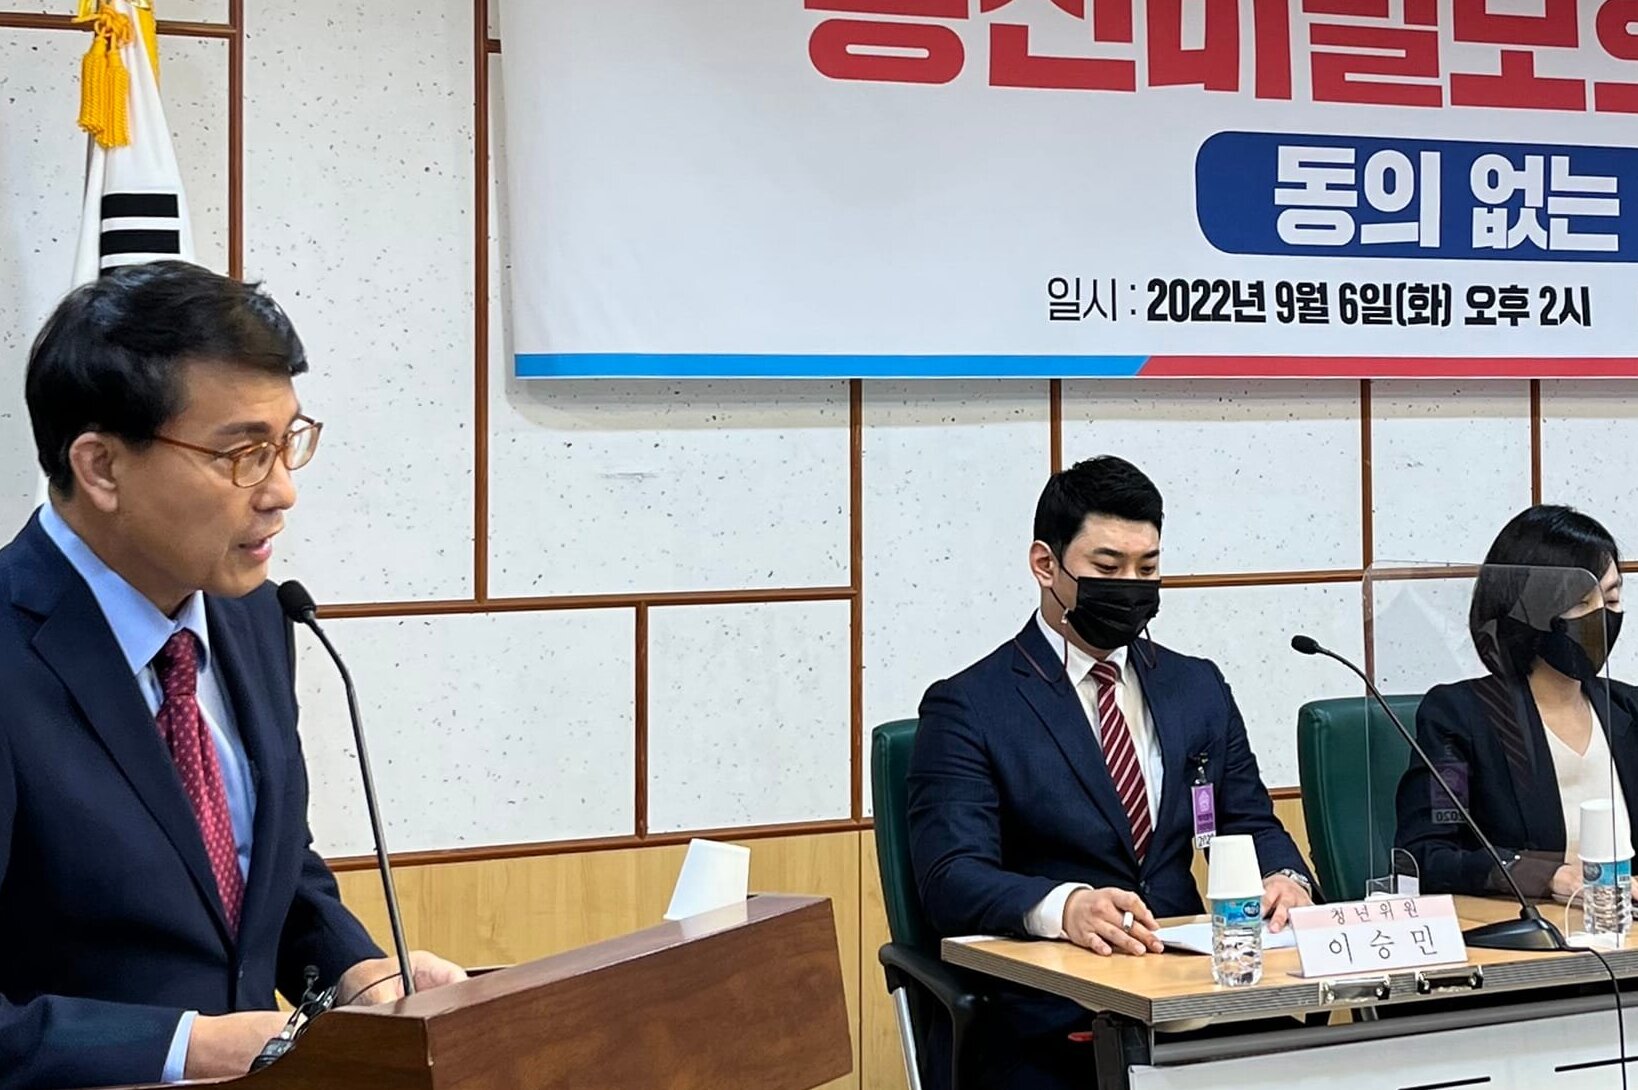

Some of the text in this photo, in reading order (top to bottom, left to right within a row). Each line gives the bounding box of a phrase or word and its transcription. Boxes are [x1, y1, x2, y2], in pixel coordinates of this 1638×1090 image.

[1274, 145, 1620, 252] 동의 없는
[1047, 277, 1117, 322] 일시
[1147, 278, 1267, 323] 2022년
[1275, 280, 1330, 324] 9월
[1338, 282, 1452, 327] 6일(화)
[1464, 284, 1530, 327] 오후
[1538, 285, 1592, 327] 2시
